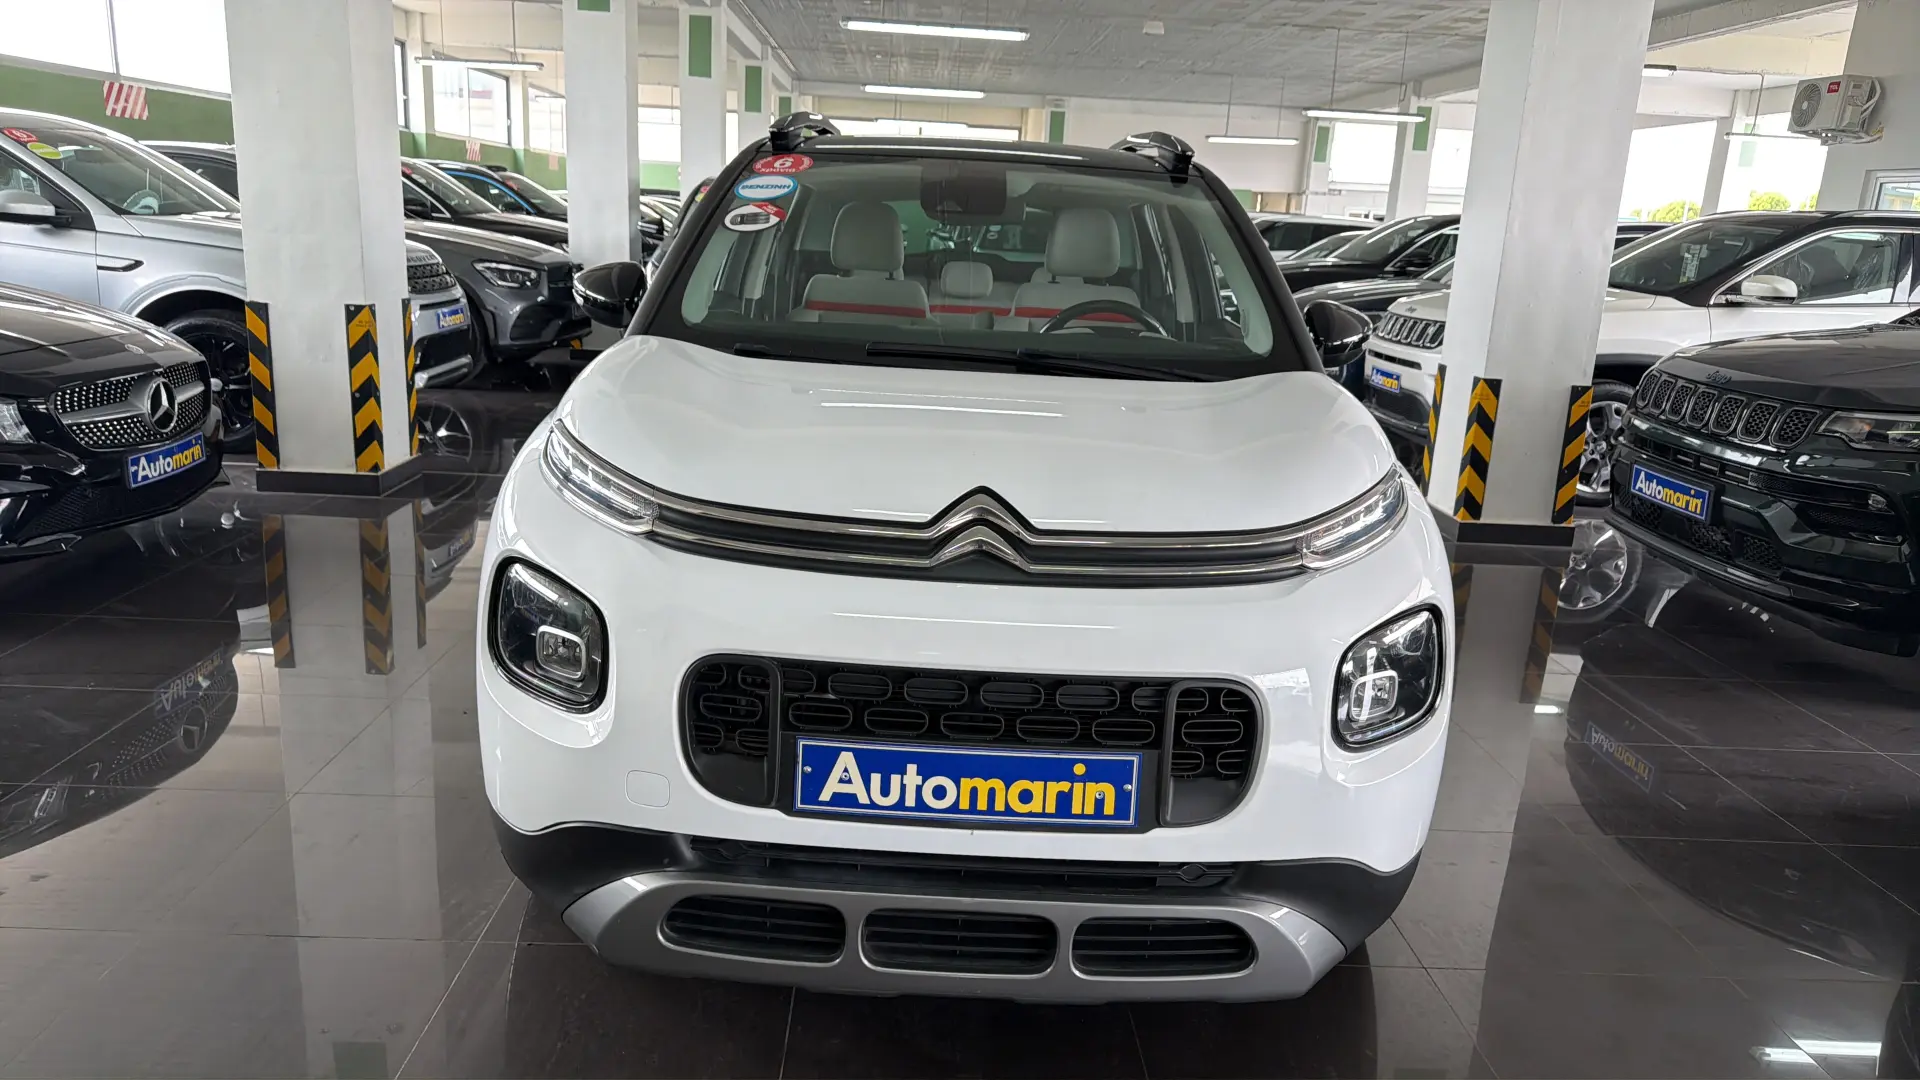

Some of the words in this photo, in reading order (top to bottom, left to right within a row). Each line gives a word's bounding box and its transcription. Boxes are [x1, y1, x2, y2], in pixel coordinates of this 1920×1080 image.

[774, 158, 794, 168] 6
[138, 439, 203, 481] Automarin
[1635, 471, 1702, 514] Automarin
[819, 751, 1115, 815] Automarin
